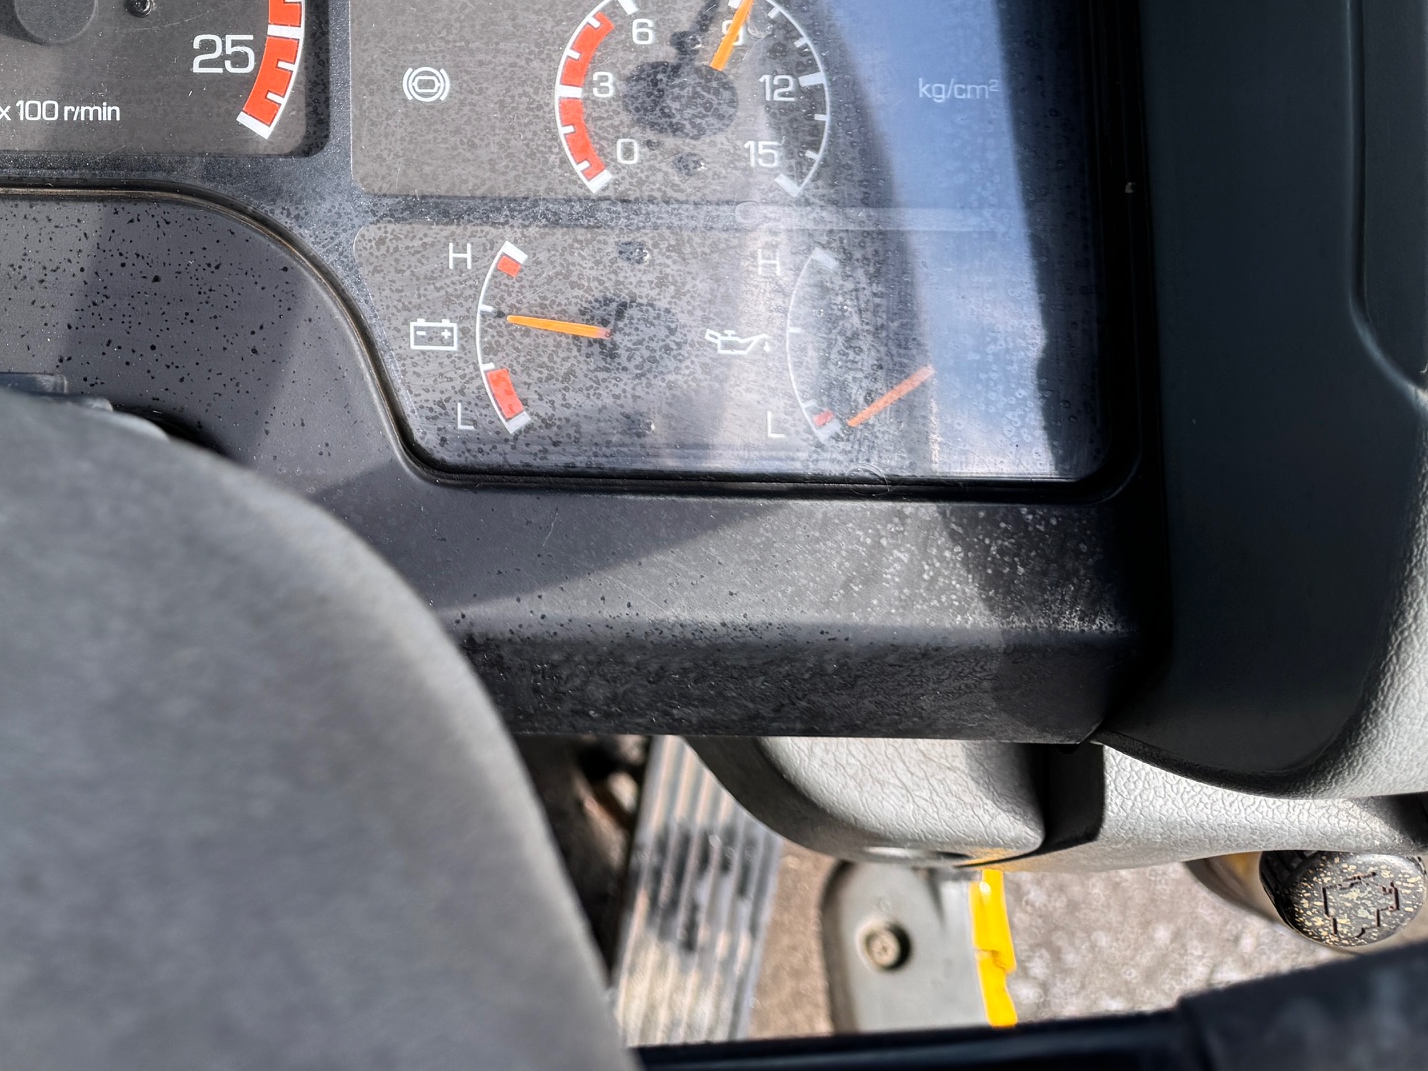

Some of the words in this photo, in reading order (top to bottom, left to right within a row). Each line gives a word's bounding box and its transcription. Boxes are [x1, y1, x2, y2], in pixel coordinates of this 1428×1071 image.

[631, 18, 655, 46] 6
[192, 33, 256, 75] 25
[592, 71, 615, 99] 3
[758, 73, 796, 102] 12
[63, 101, 120, 121] r/min
[616, 138, 641, 166] 0
[743, 140, 780, 168] 15
[449, 243, 471, 269] H
[757, 248, 781, 276] H
[457, 402, 474, 430] L
[767, 410, 786, 438] L
